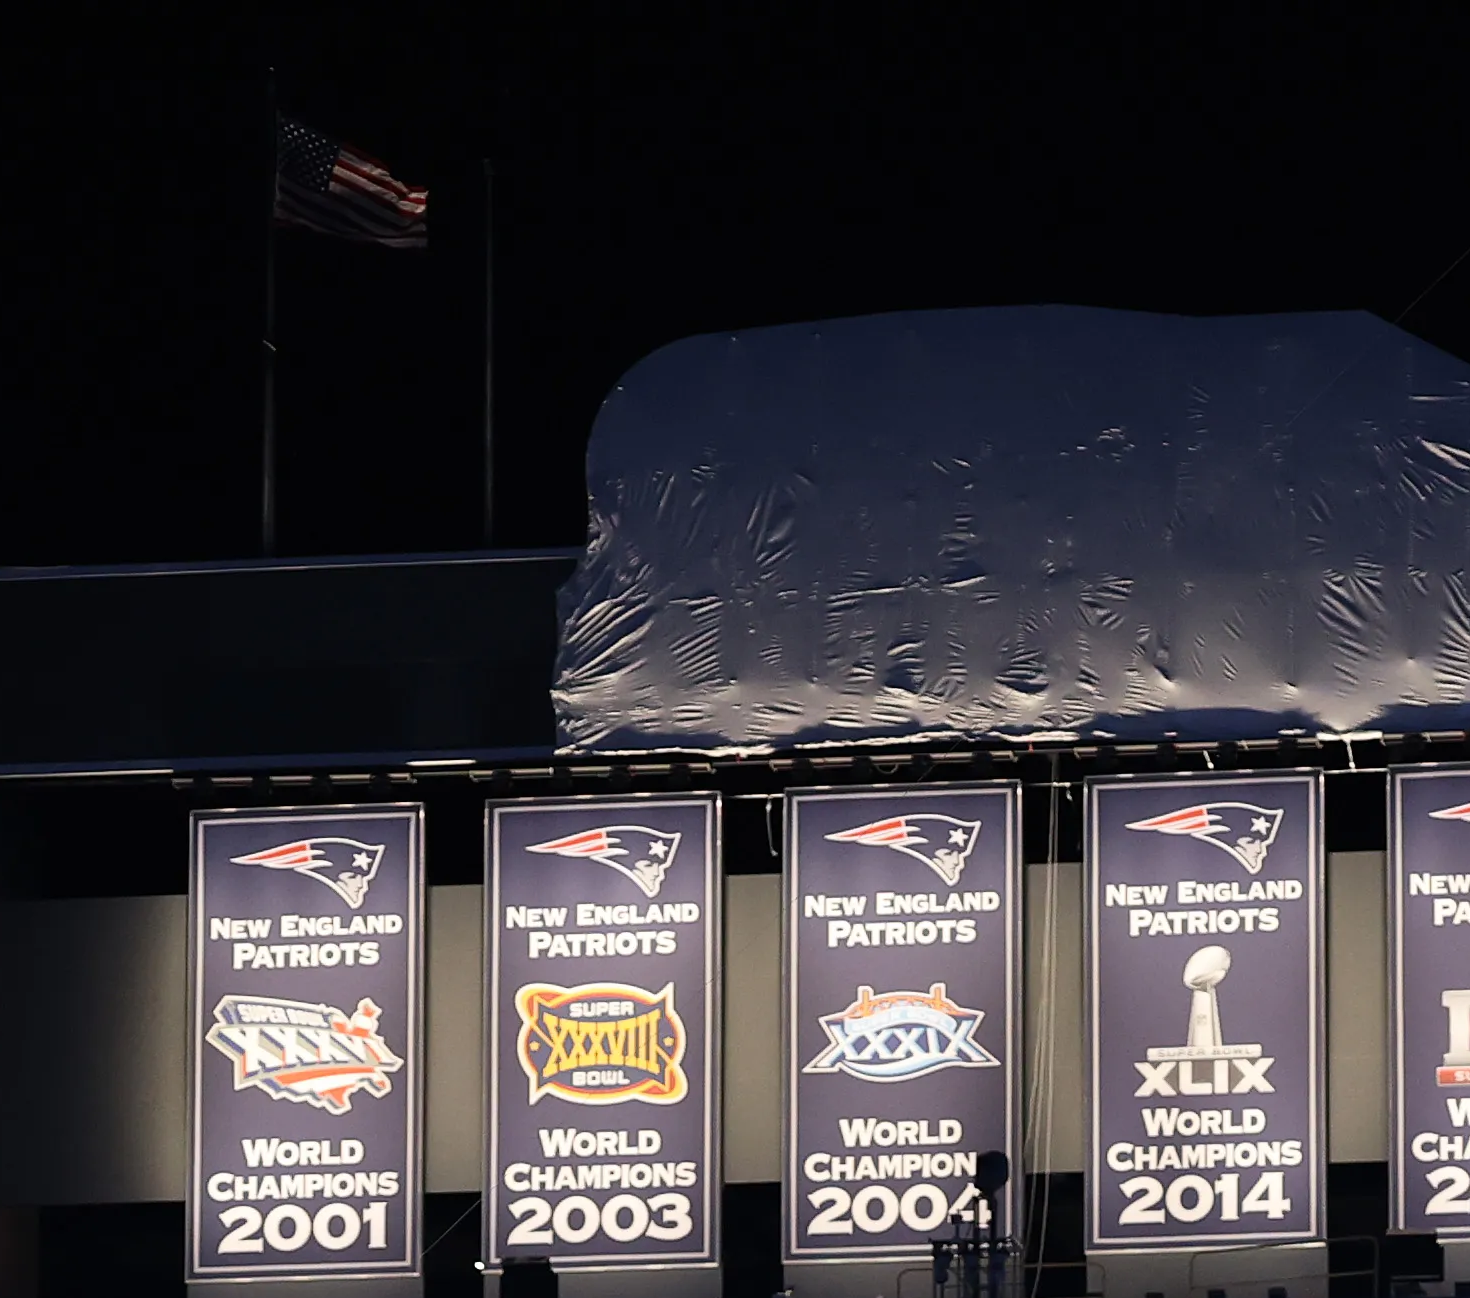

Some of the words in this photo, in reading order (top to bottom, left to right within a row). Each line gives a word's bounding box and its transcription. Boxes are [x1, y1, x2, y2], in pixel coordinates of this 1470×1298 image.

[805, 894, 868, 918] NEW
[876, 890, 1000, 914] ENGLAND
[1105, 883, 1168, 907] NEW
[1177, 880, 1302, 904] ENGLAND
[210, 917, 270, 940] NEW
[280, 914, 403, 937] ENGLAND
[506, 905, 568, 929] NEW
[576, 902, 698, 925] ENGLAND
[1129, 908, 1279, 937] PATRIOTS
[529, 931, 676, 958] PATRIOTS
[828, 919, 976, 948] PATRIOTS
[233, 942, 380, 970] PATRIOTS
[569, 1001, 635, 1018] SUPER
[541, 1015, 661, 1075] XXXVIII
[814, 1020, 987, 1067] XXXIX
[571, 1070, 631, 1087] BOWL
[1134, 1058, 1275, 1097] XLIX
[839, 1118, 962, 1147] WORLD
[1142, 1108, 1266, 1137] WORLD
[241, 1138, 364, 1167] WORLD
[539, 1128, 661, 1158] WORLD
[1107, 1140, 1302, 1171] CHAMPIONS
[504, 1162, 696, 1191] CHAMPIONS
[804, 1152, 976, 1182] CHAMPION
[207, 1172, 399, 1201] CHAMPIONS
[1119, 1172, 1291, 1224] 2014
[218, 1202, 387, 1253] 2001
[507, 1193, 692, 1245] 2003
